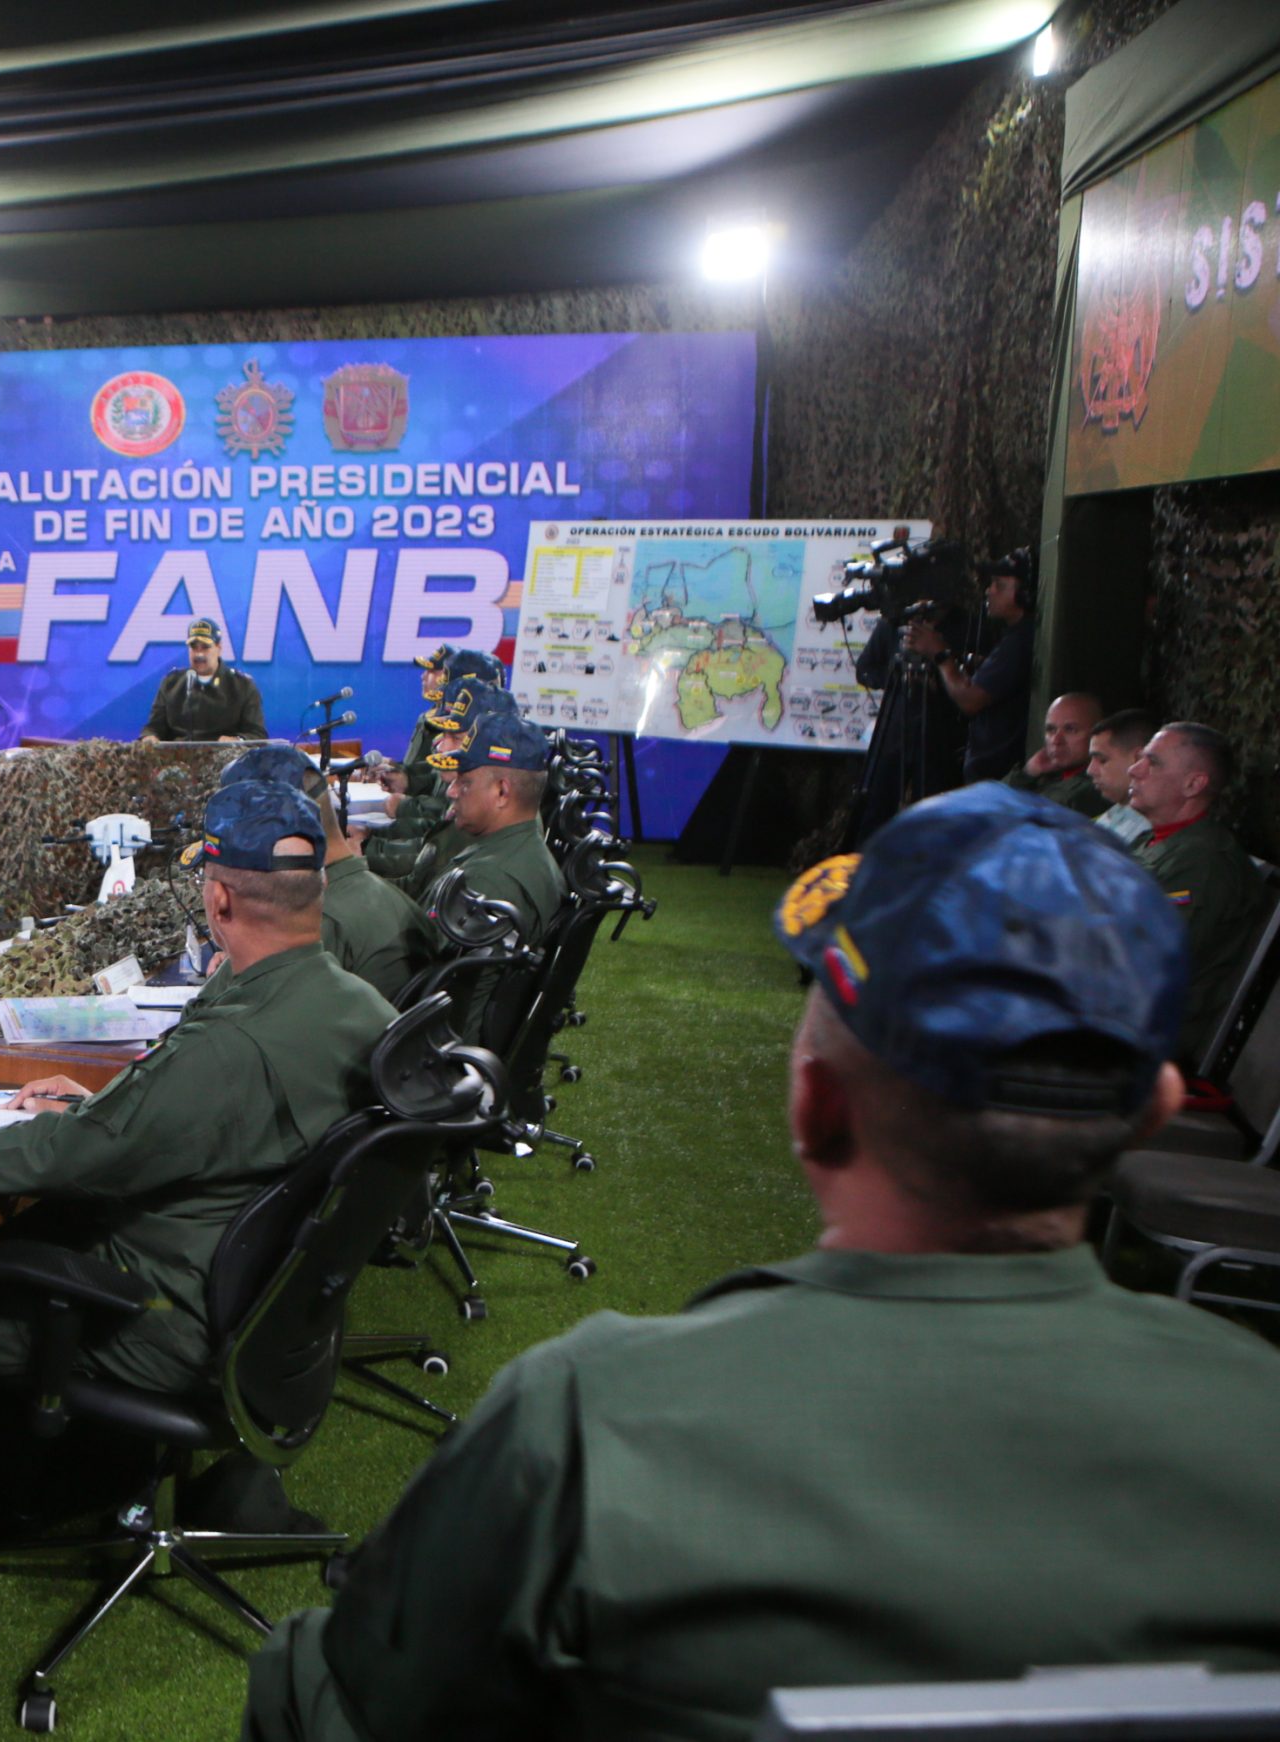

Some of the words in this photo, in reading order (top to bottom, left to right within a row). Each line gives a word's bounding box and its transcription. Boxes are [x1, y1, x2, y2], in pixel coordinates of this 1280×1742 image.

[1184, 191, 1280, 310] SIS
[250, 461, 581, 499] PRESIDENCIAL
[33, 509, 87, 542] DE
[105, 508, 171, 541] FIN
[189, 507, 244, 540] DE
[260, 499, 355, 540] AÑO
[372, 504, 496, 539] 2023
[570, 525, 637, 537] OPERACIÓN
[640, 525, 724, 538] ESTRATÉGICA
[728, 526, 780, 538] ESCUDO
[785, 526, 878, 538] BOLIVARIANO
[16, 547, 510, 663] FANB
